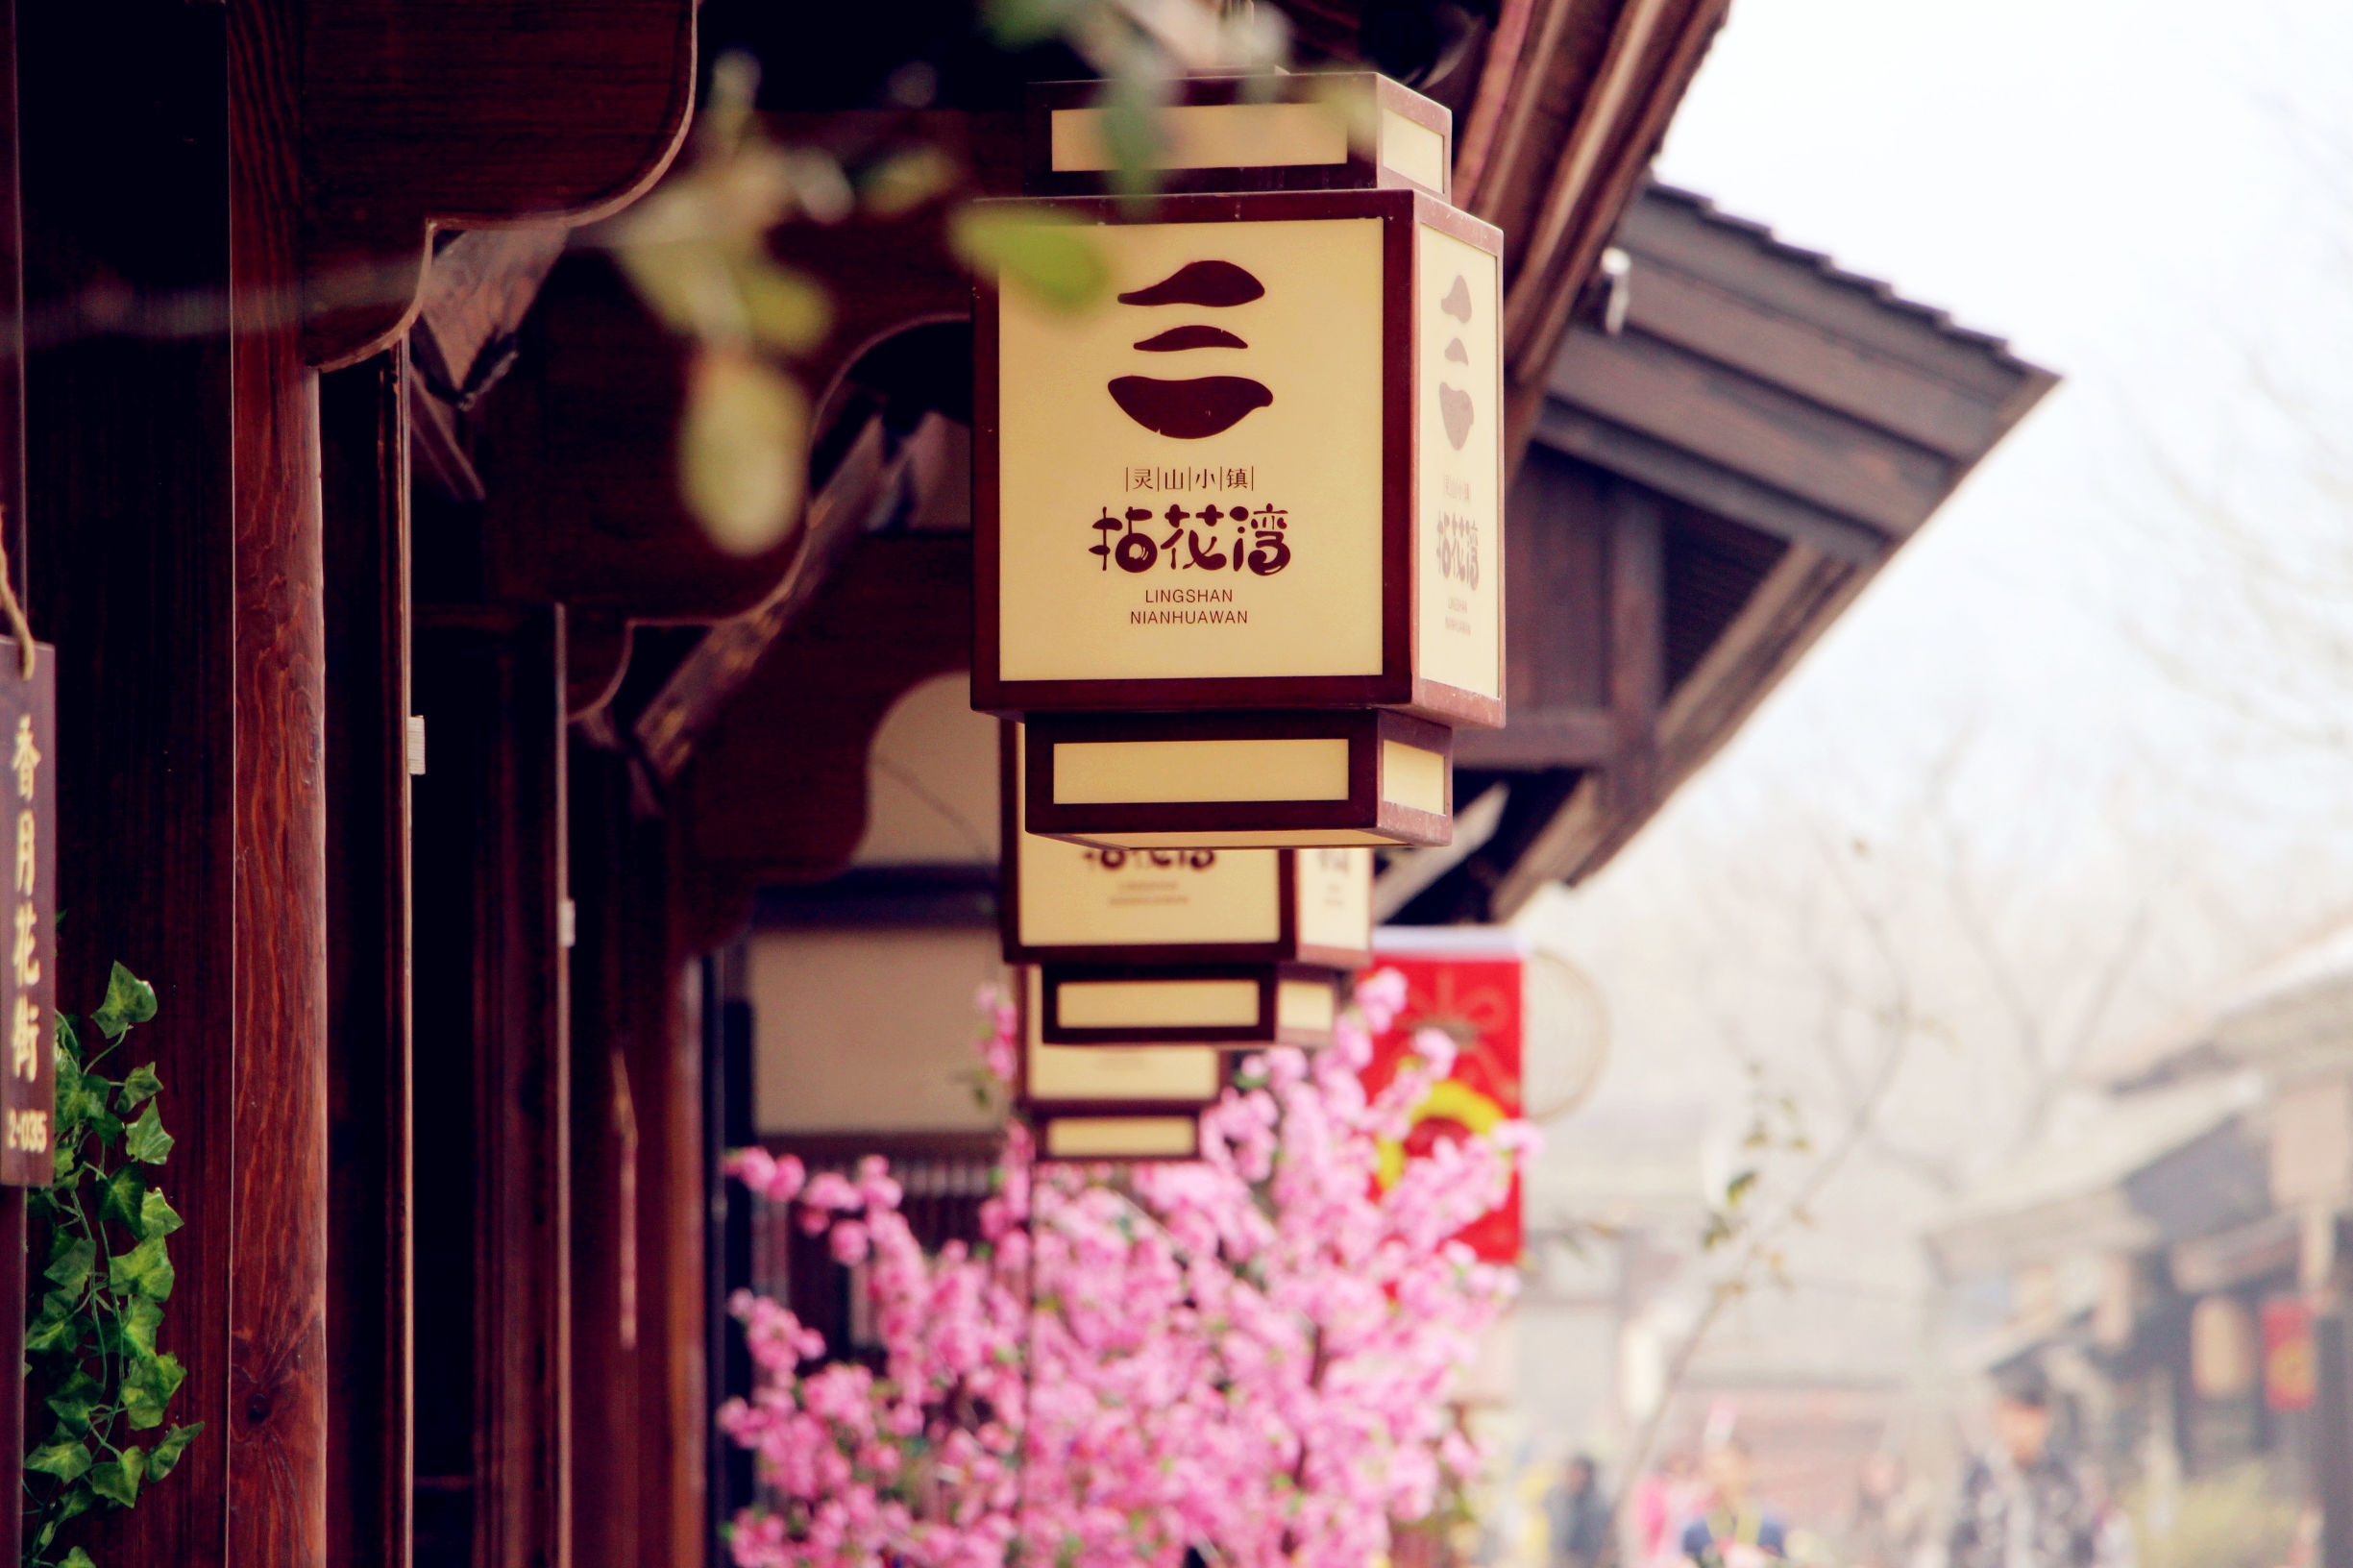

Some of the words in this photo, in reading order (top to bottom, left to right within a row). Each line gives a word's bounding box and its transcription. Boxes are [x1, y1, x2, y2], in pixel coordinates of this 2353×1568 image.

[1089, 502, 1291, 576] 拈花湾
[1145, 589, 1233, 603] LINGSHAN
[1130, 610, 1248, 625] NIANHUAWAN
